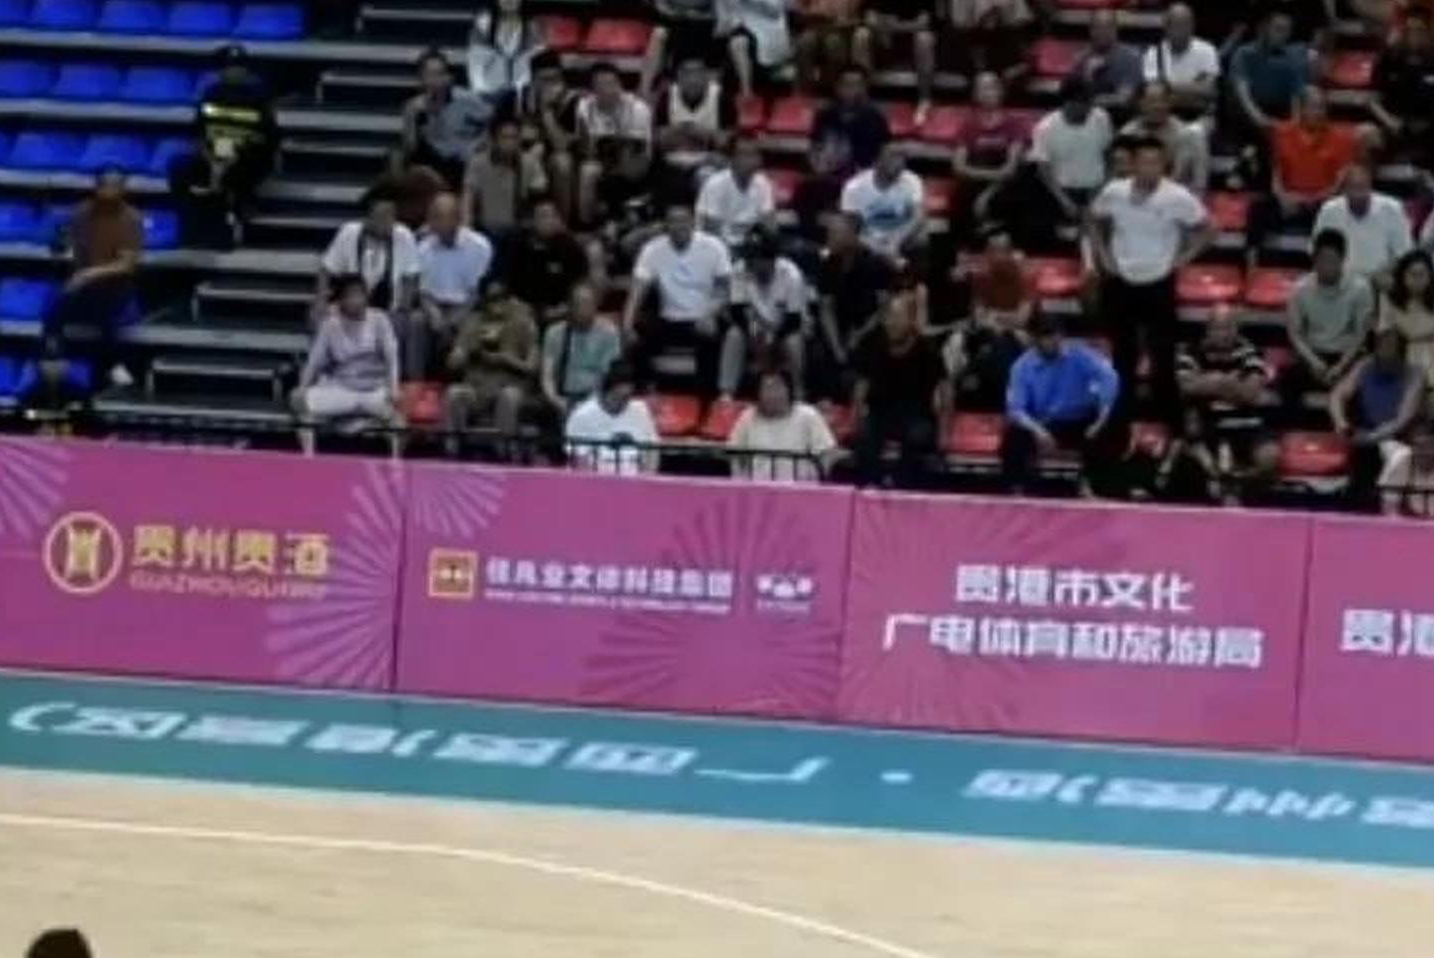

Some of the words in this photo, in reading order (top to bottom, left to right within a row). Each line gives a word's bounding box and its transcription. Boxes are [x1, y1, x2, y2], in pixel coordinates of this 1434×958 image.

[133, 524, 330, 575] 贵州贵酒
[956, 564, 1194, 612] 贵港市文化
[883, 612, 1264, 668] 广电体育和旅游局
